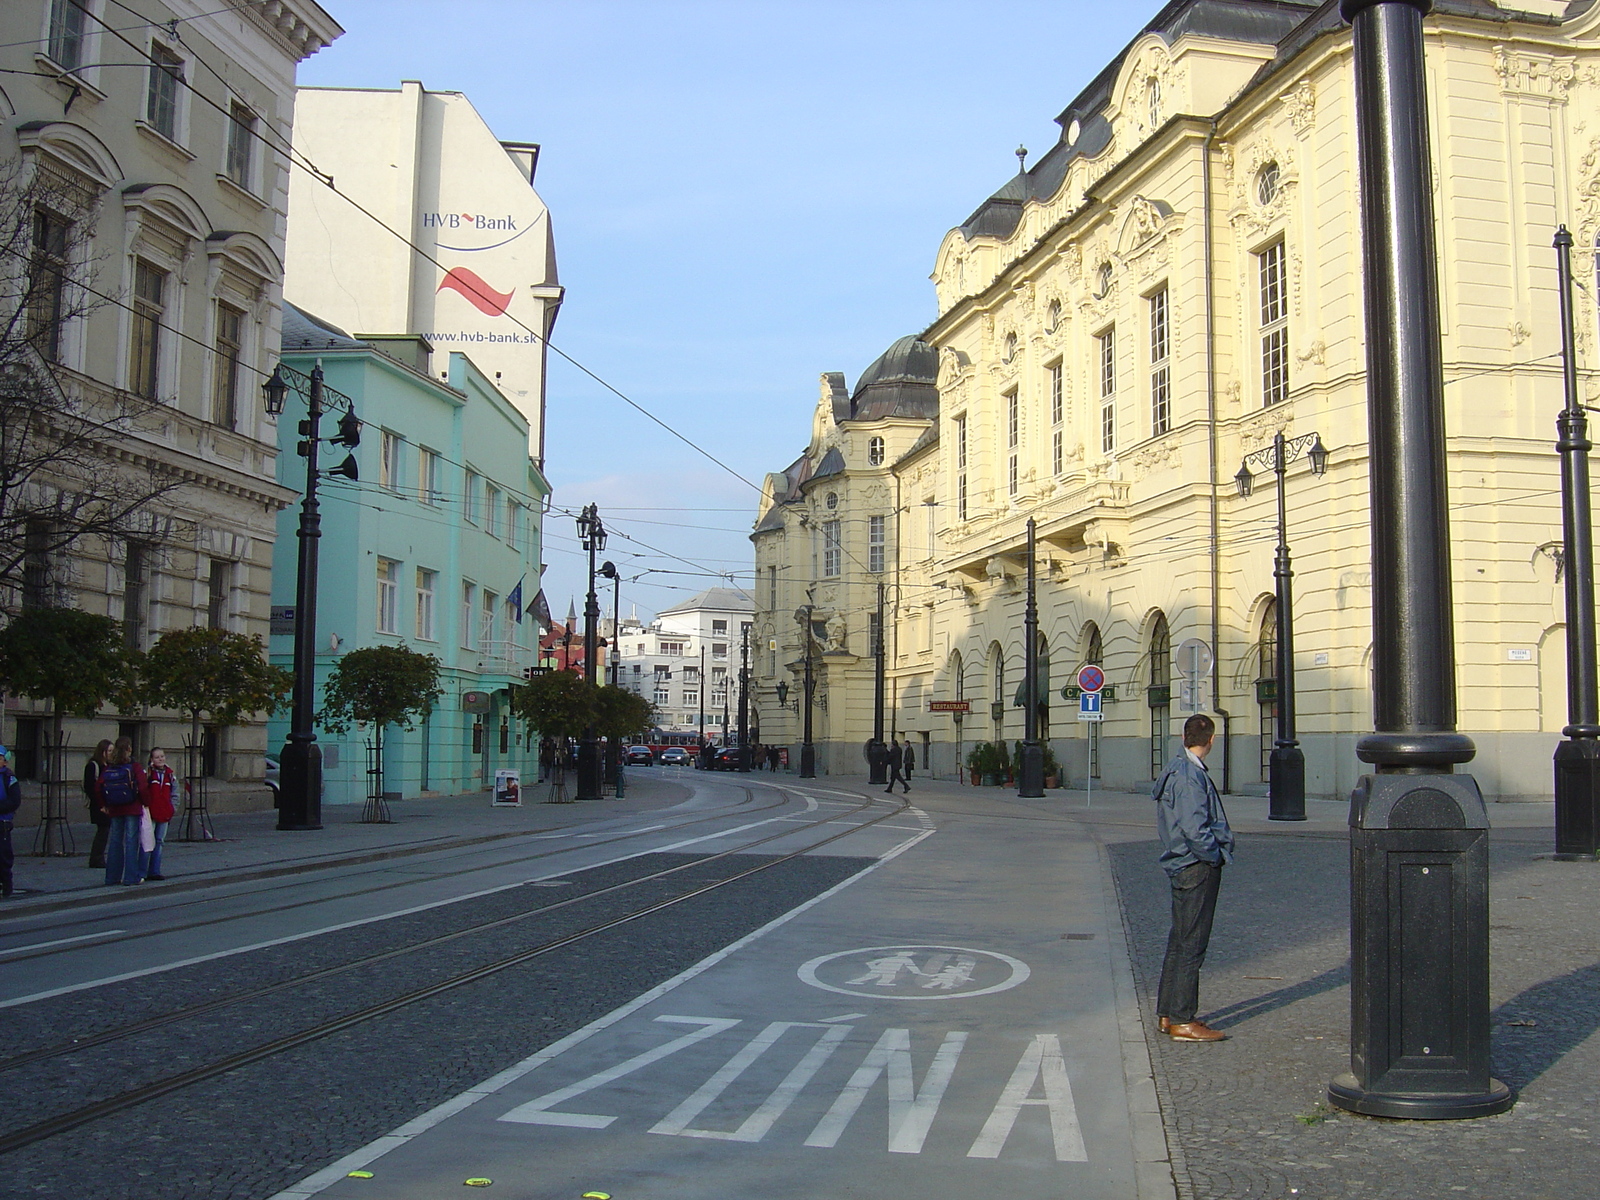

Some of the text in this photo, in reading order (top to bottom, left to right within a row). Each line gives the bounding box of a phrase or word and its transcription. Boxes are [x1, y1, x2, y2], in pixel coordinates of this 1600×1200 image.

[423, 213, 517, 230] HVB Bank
[421, 331, 537, 344] www.hvb-bank.sk
[496, 1013, 1089, 1162] ZÓNA
